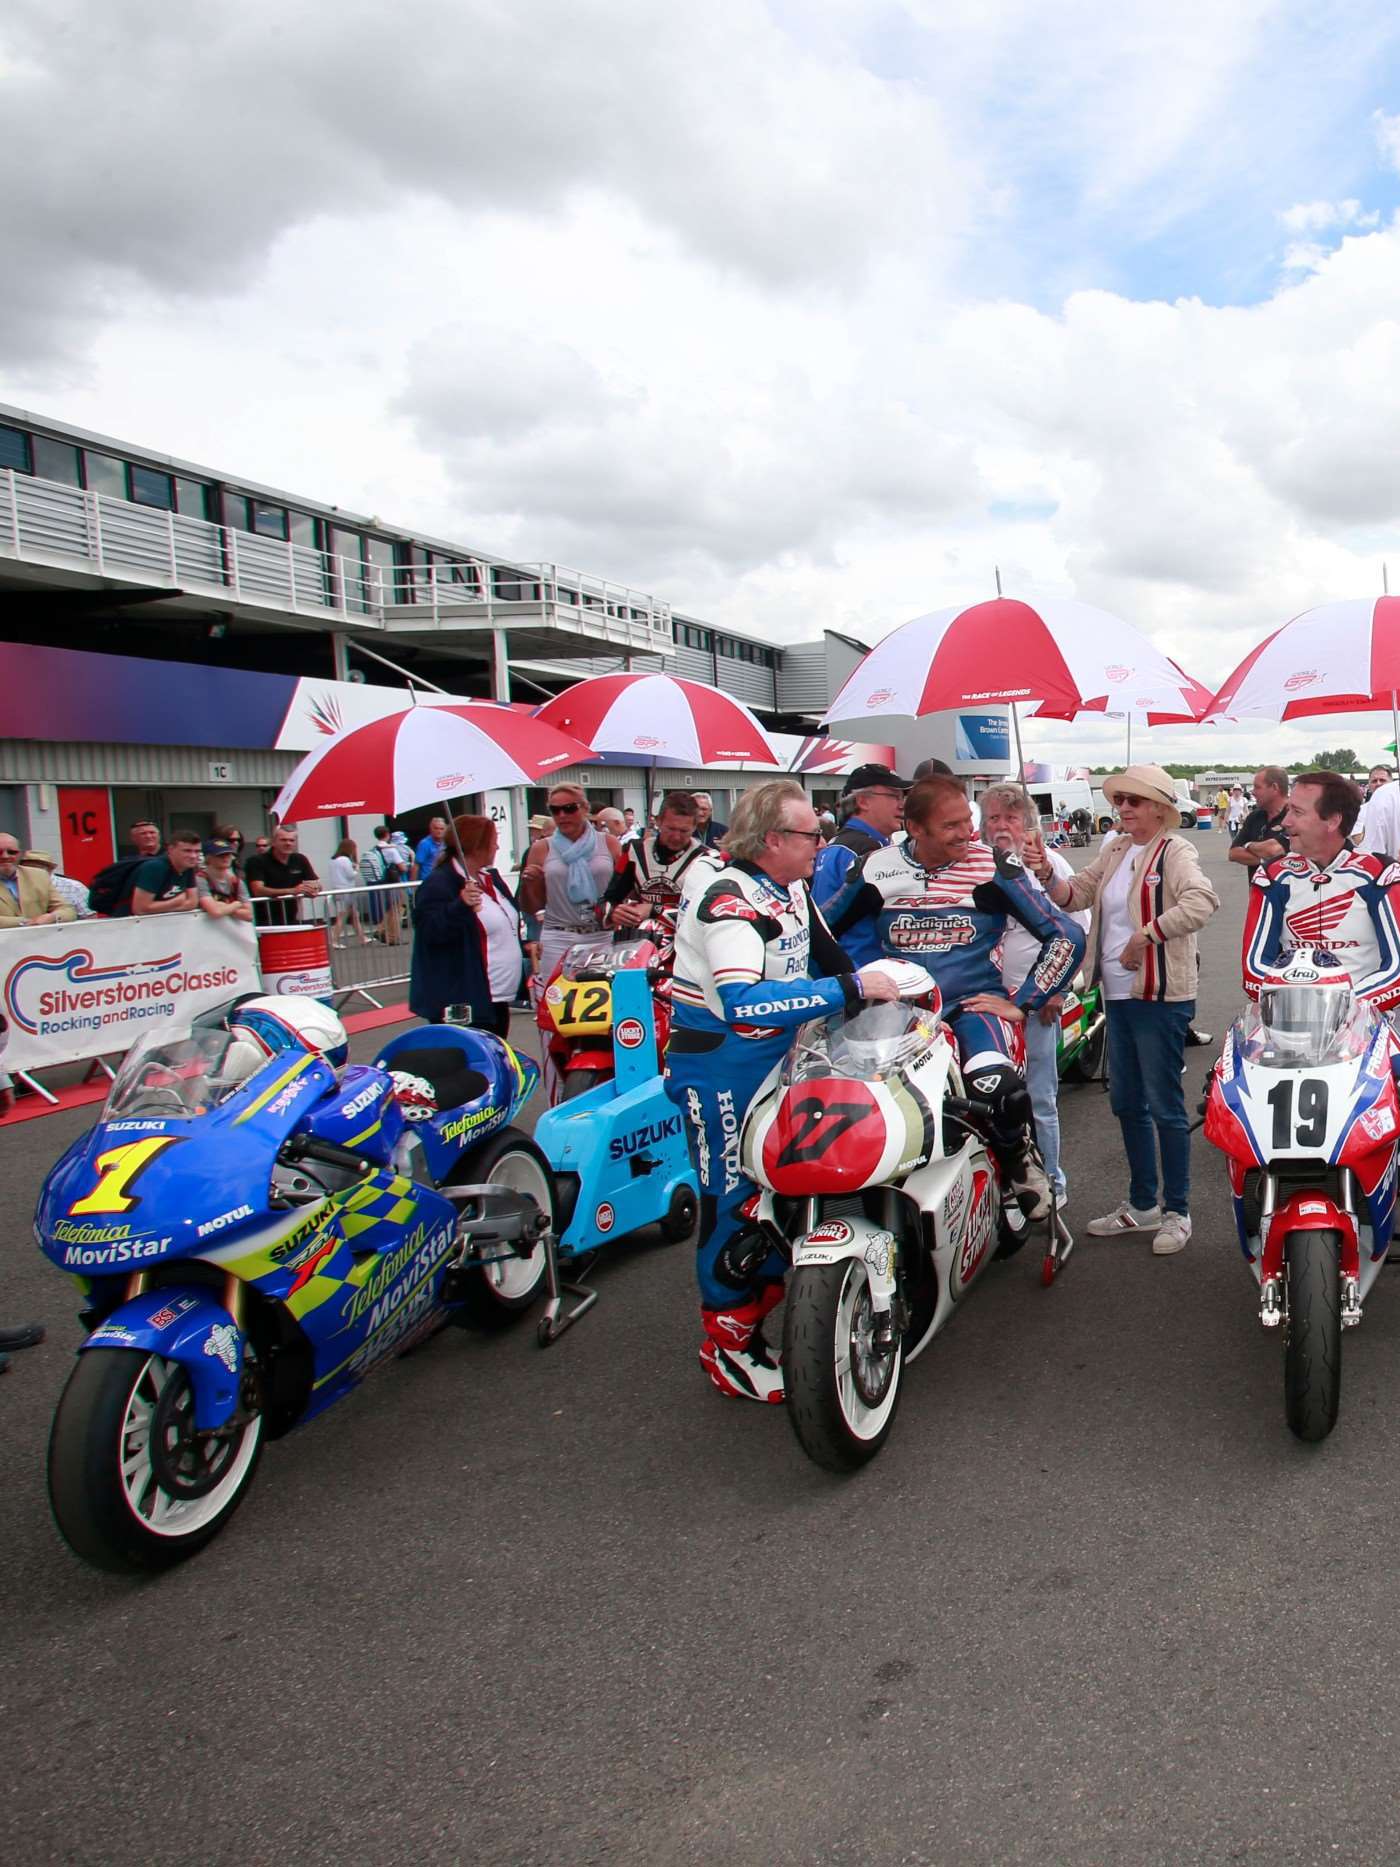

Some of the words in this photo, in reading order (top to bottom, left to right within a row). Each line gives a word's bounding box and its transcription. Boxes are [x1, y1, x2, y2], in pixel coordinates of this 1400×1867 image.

[971, 691, 990, 699] RACE
[998, 688, 1032, 698] LEGENDS
[214, 766, 228, 778] 1C
[68, 811, 98, 836] 1C
[490, 806, 506, 822] 2A
[1289, 940, 1361, 951] HONDA
[1285, 968, 1315, 979] Arai
[39, 966, 239, 1016] SilverstoneClassic
[558, 986, 610, 1026] 12
[733, 994, 829, 1018] HONDA
[40, 1001, 176, 1036] RockingandRacing
[911, 1050, 934, 1073] MOTUL
[341, 1082, 385, 1119] SUZUKI
[1267, 1078, 1329, 1150] 19
[105, 1121, 167, 1133] SUZUKI
[608, 1114, 683, 1161] SUZUKI
[717, 1089, 740, 1195] HONDA
[775, 1097, 874, 1169] 27
[68, 1135, 183, 1217] 1
[898, 1153, 929, 1171] MOTUL
[197, 1204, 255, 1237] MOTUL
[270, 1200, 336, 1261] SUZUKI
[64, 1235, 173, 1266] MoviStar
[366, 1219, 454, 1338] MoviStar
